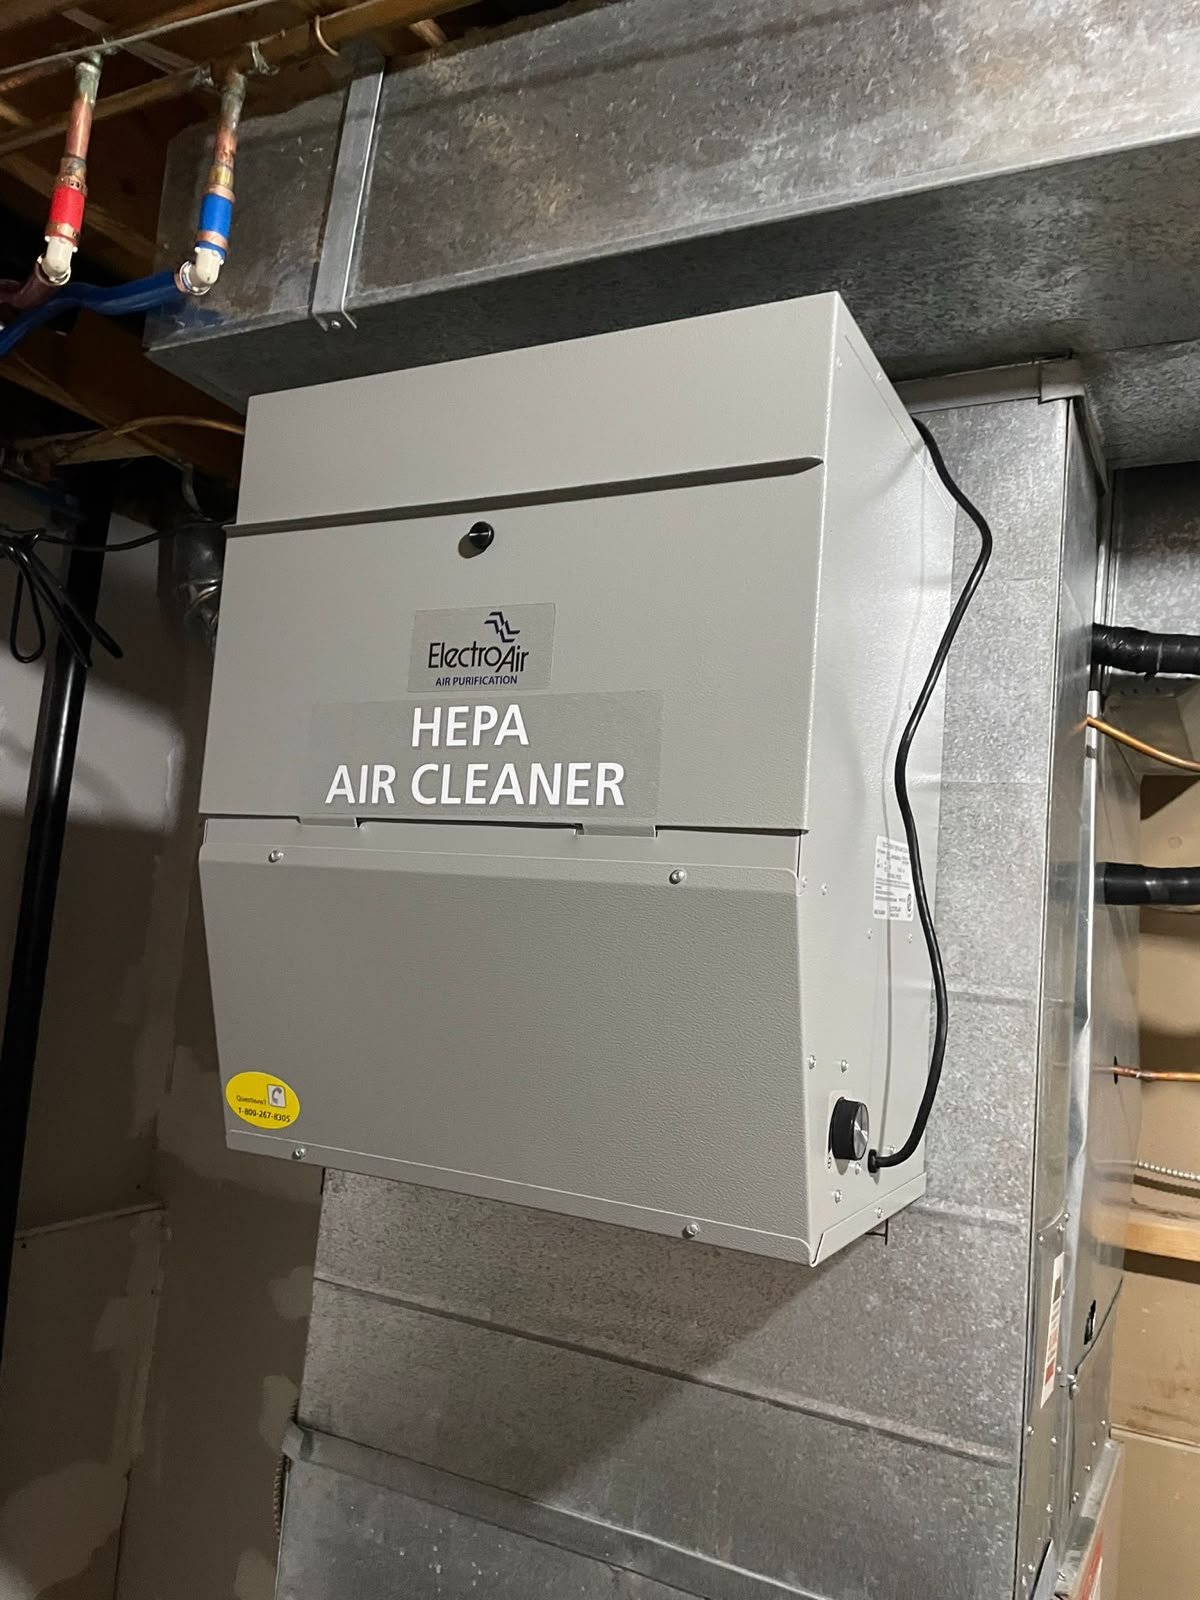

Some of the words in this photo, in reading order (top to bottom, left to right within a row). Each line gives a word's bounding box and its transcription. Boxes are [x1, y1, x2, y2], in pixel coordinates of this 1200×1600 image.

[428, 641, 529, 673] ElectroAir
[435, 677, 451, 687] AIR
[452, 675, 518, 686] PURIFICATION
[411, 704, 530, 748] HEPA
[325, 764, 397, 805] AIR
[411, 762, 625, 807] CLEANER
